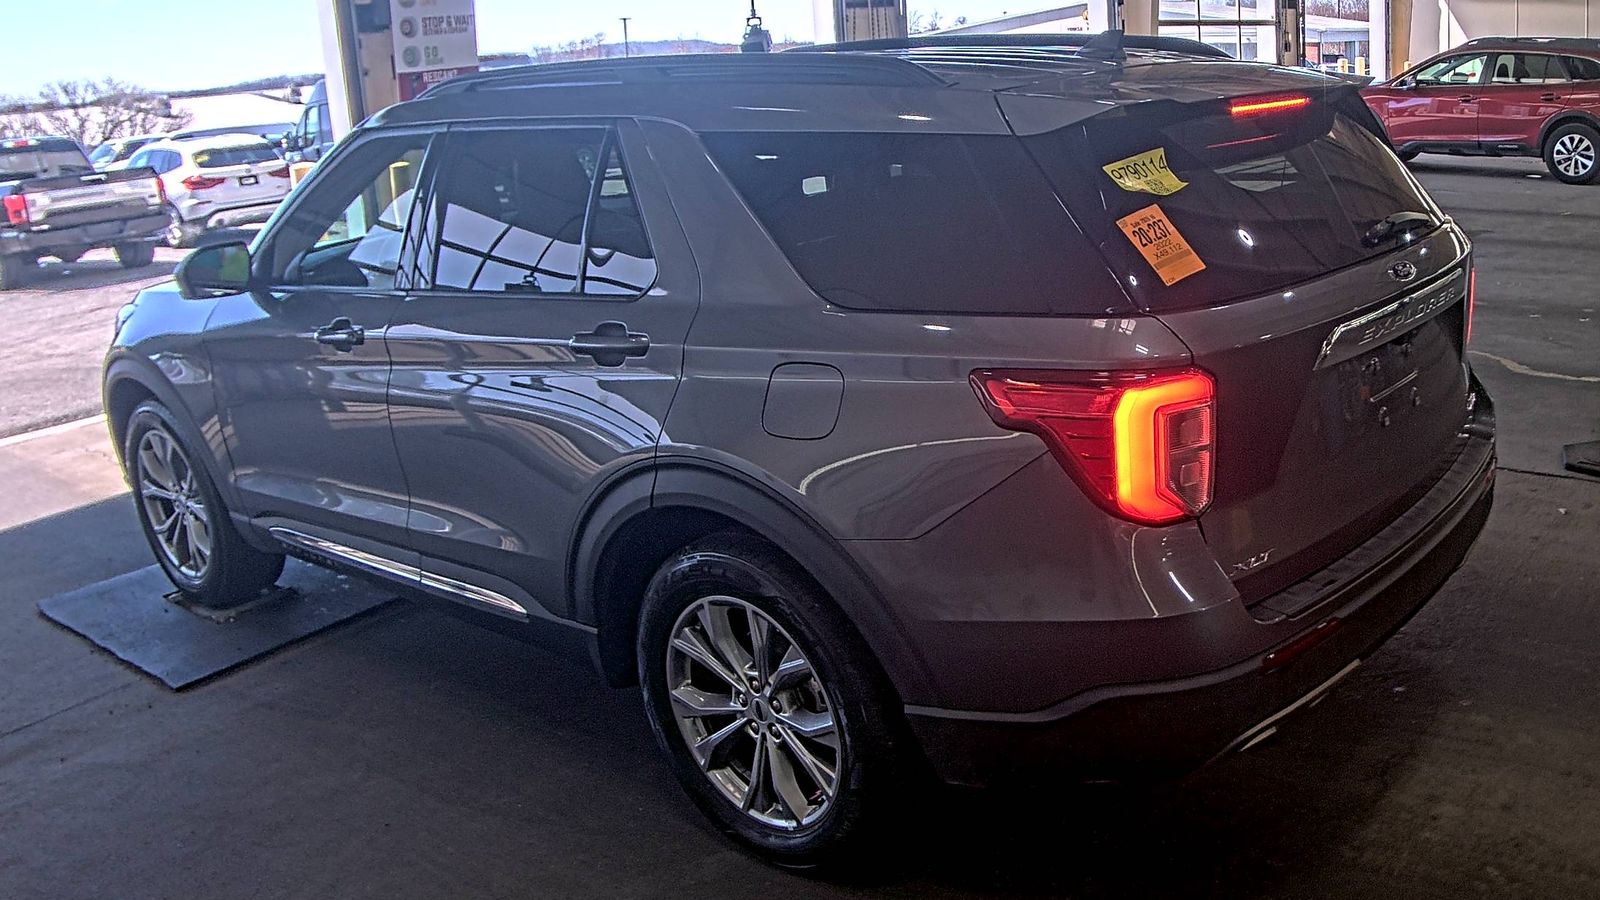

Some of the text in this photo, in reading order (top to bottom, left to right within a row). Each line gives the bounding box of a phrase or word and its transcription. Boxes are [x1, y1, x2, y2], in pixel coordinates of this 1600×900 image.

[422, 16, 444, 28] STOP
[454, 15, 473, 26] WAIT
[424, 46, 438, 57] GO
[1111, 154, 1168, 182] 9790114
[1132, 219, 1171, 248] 20:237
[1153, 238, 1173, 250] 2022
[1358, 288, 1455, 345] EXPLORER
[1230, 548, 1275, 576] XLT
